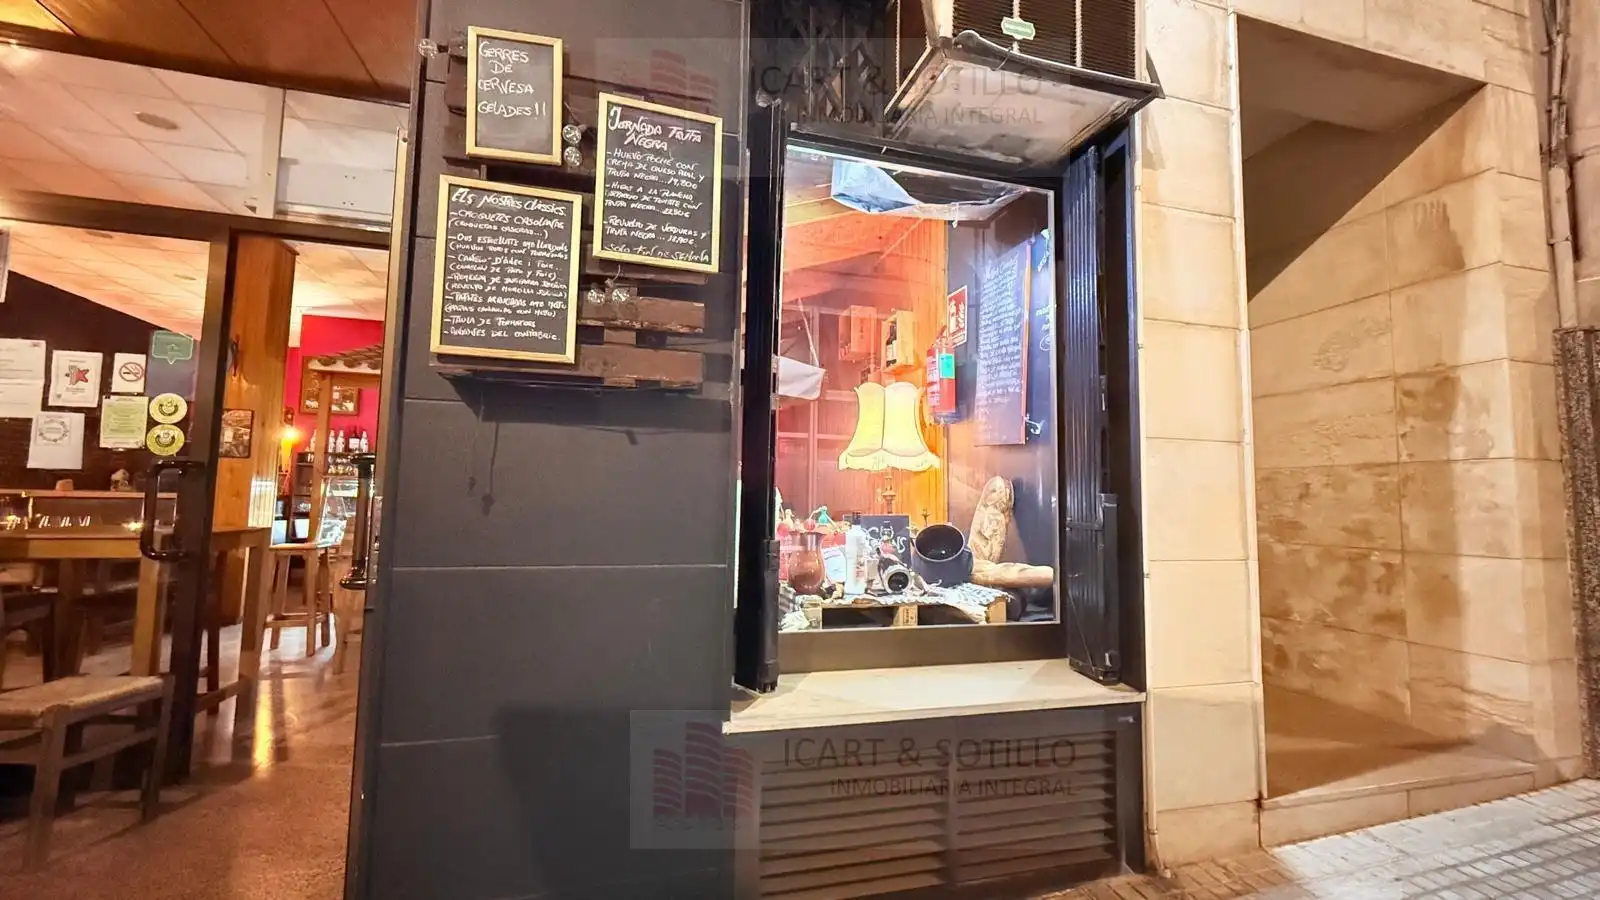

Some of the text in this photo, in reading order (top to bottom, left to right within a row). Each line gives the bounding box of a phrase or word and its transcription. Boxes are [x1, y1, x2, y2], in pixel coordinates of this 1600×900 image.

[479, 41, 529, 63] GERRES
[488, 60, 513, 74] DE
[478, 77, 534, 94] CERVESA
[608, 106, 662, 136] JORNADA
[624, 131, 668, 151] NEGRA
